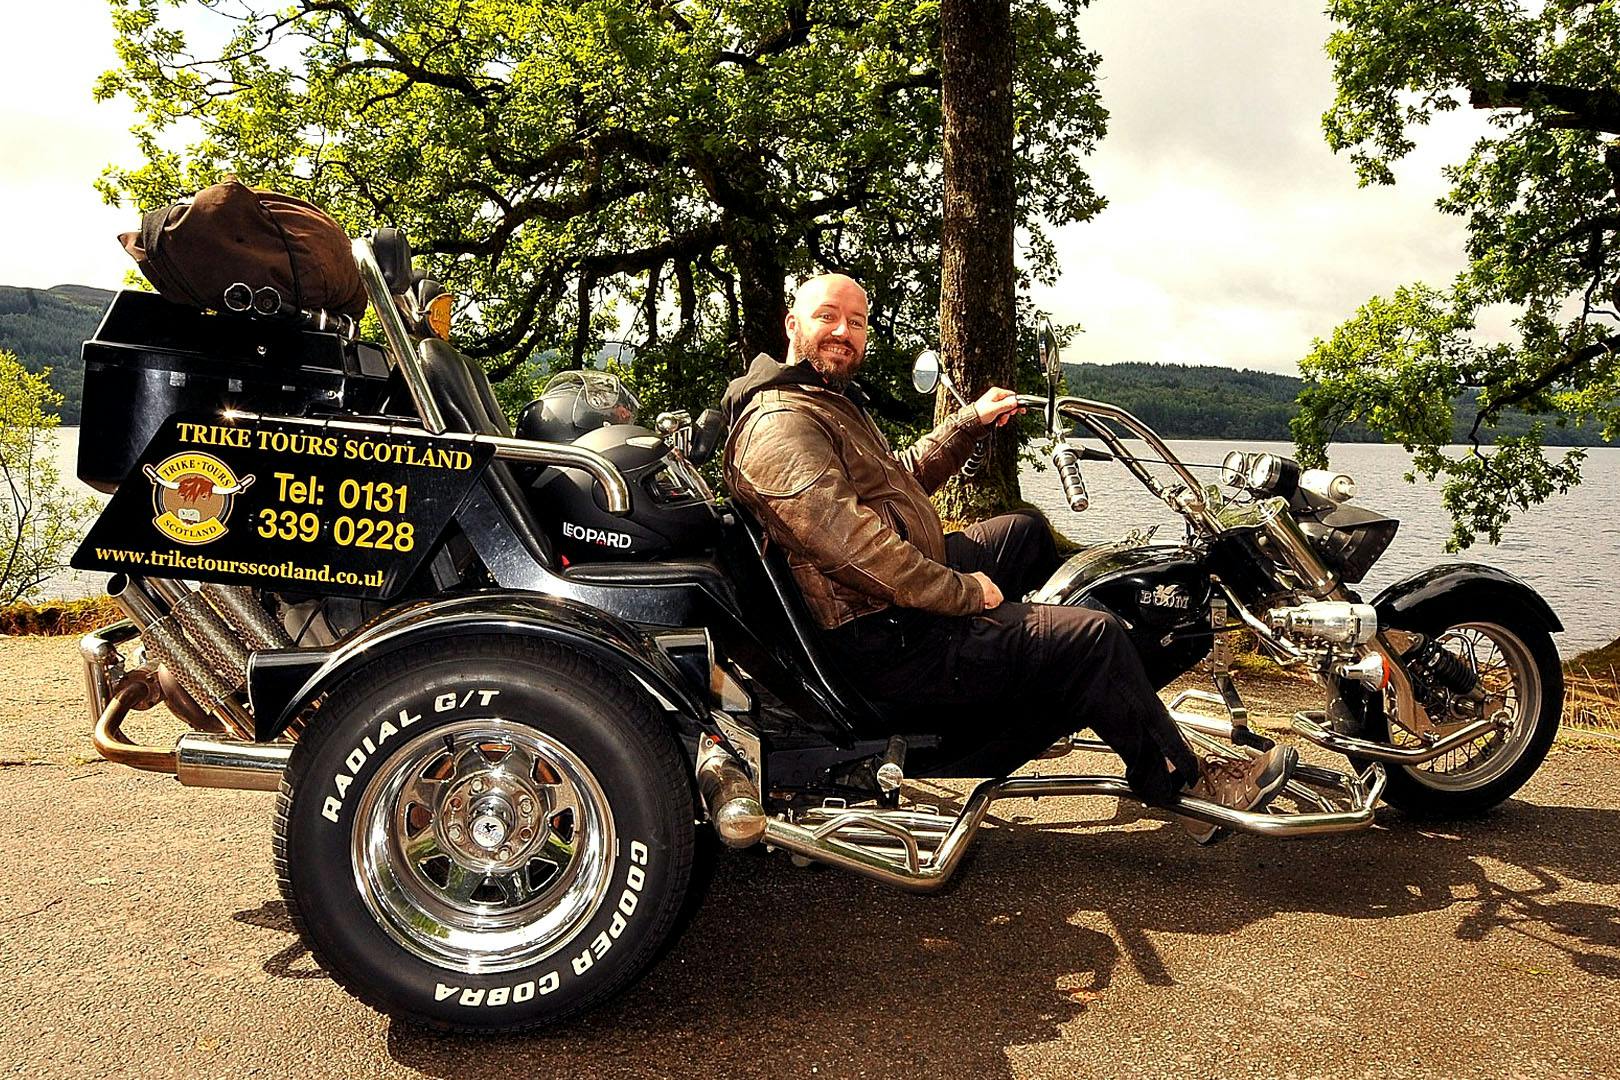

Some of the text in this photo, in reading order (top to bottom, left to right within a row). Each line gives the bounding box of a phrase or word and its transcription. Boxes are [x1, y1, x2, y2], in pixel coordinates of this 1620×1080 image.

[177, 422, 473, 471] TRIKE TOURS SCOTLAND
[162, 459, 232, 487] TRIKE TOURS
[274, 472, 408, 514] Tel: 0131
[163, 519, 217, 538] SCOTLAND
[257, 508, 415, 552] 339 0228
[563, 521, 632, 549] LEOPARD
[321, 689, 500, 823] RADIAL G/T
[434, 840, 648, 1007] COOPER COBRA
